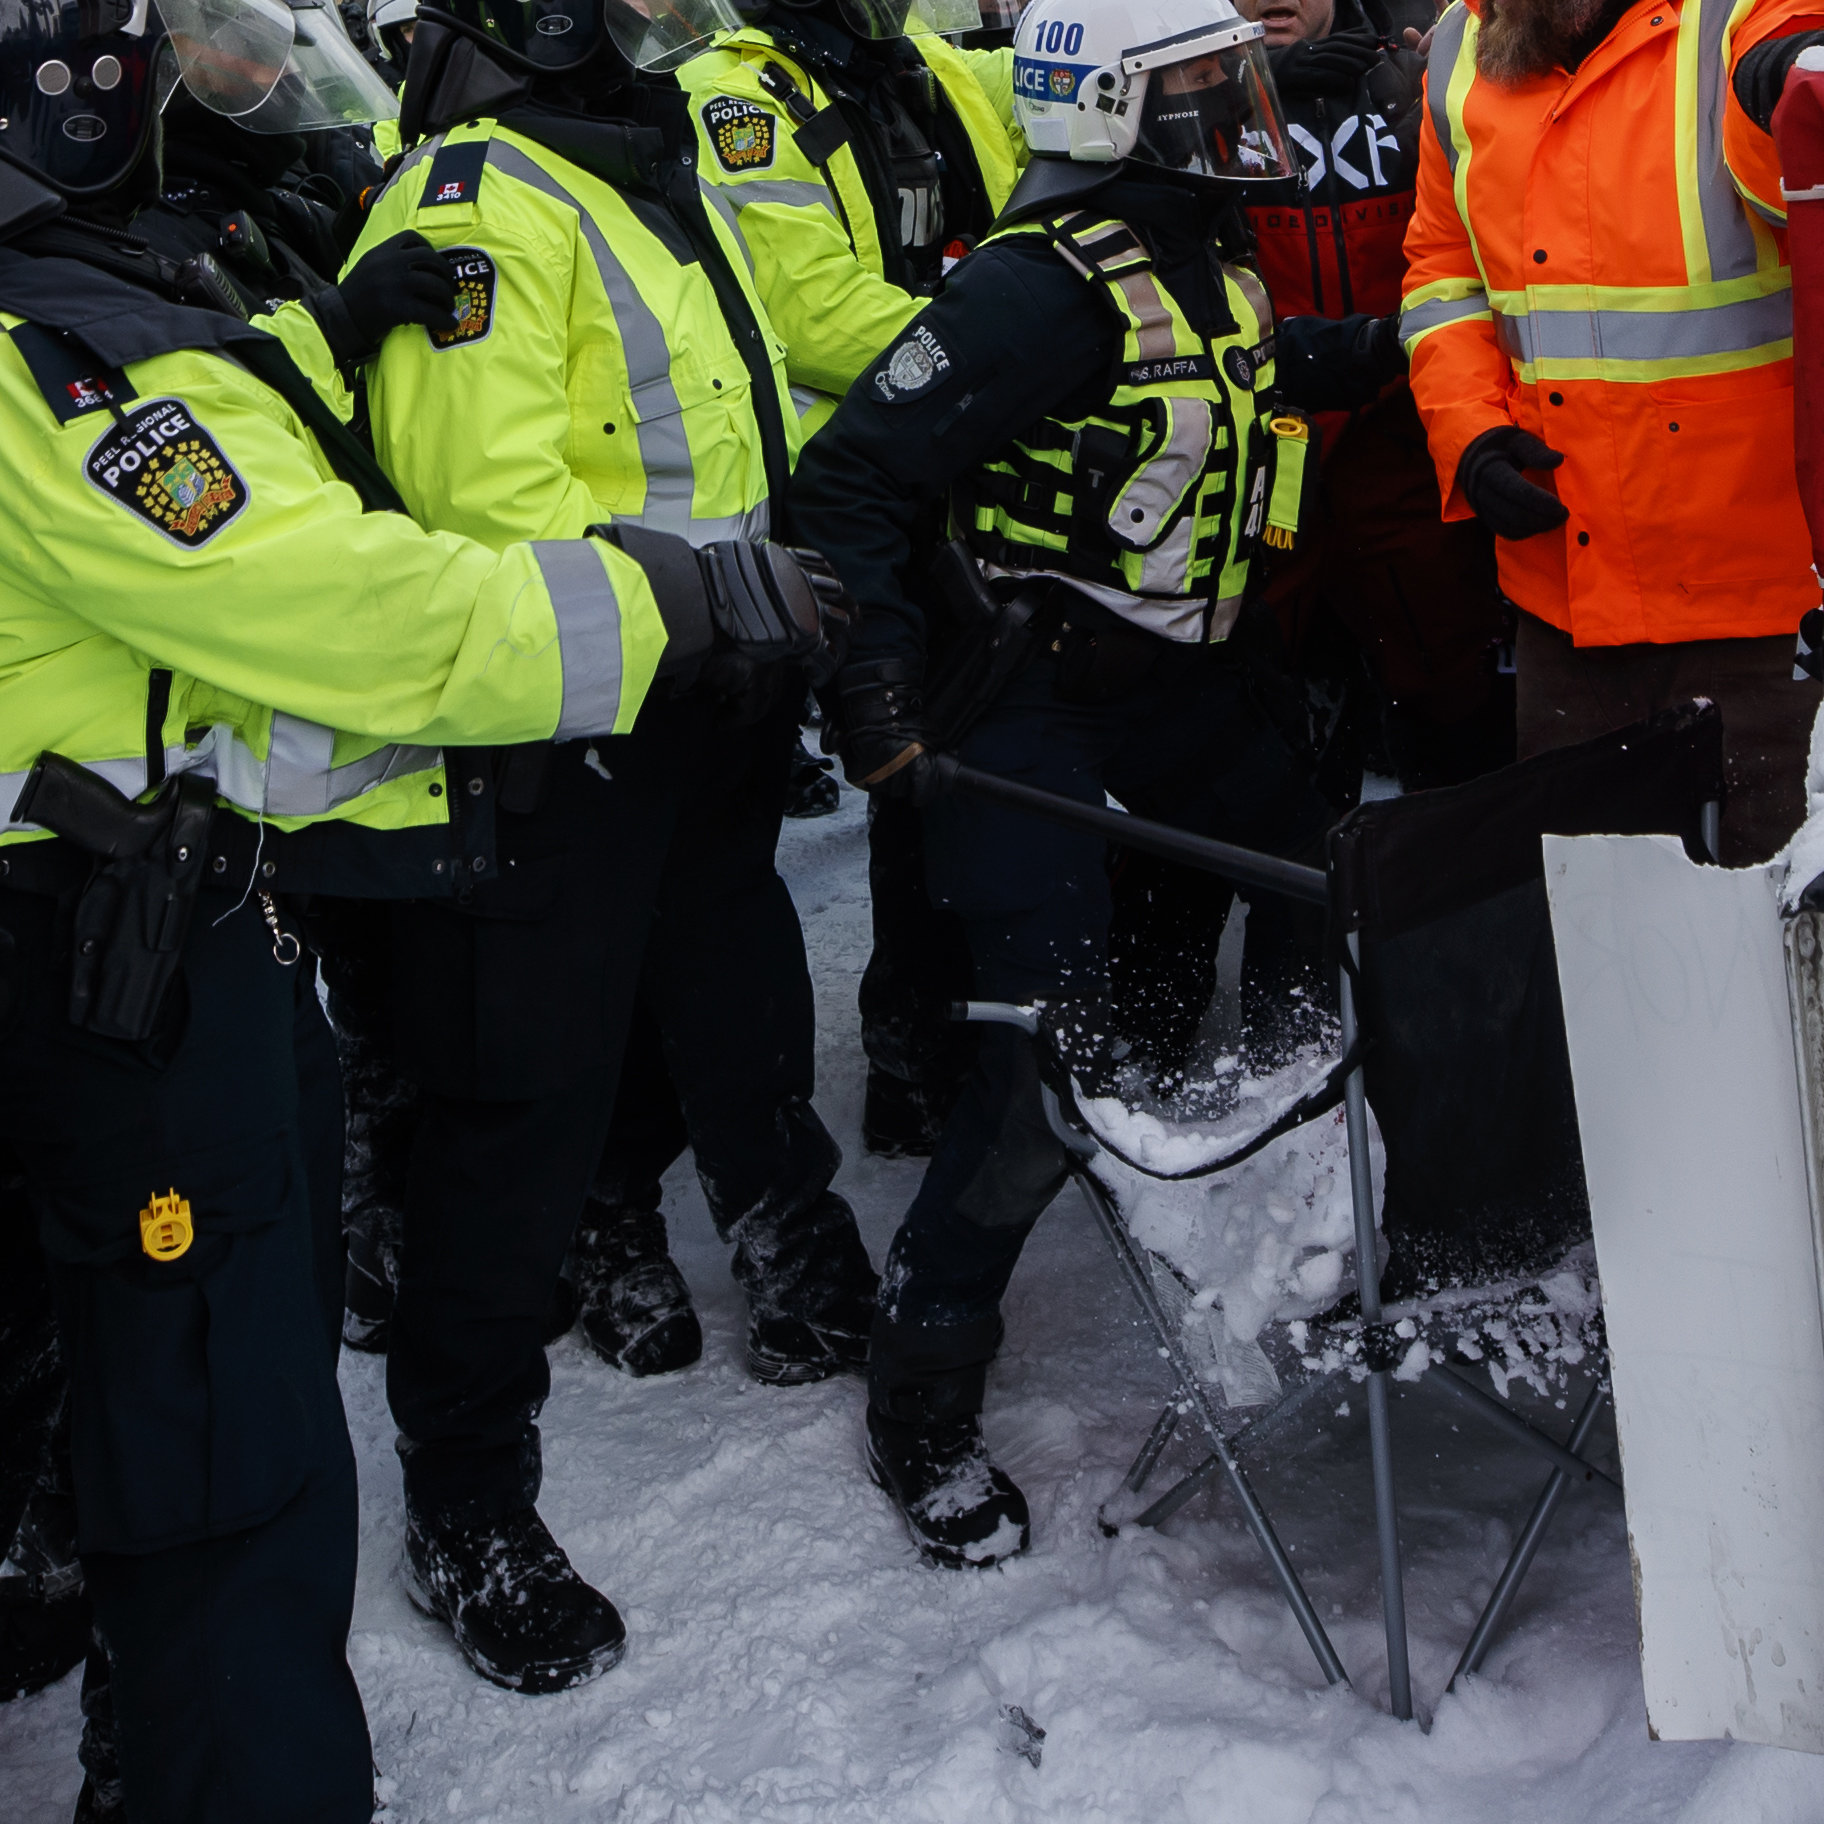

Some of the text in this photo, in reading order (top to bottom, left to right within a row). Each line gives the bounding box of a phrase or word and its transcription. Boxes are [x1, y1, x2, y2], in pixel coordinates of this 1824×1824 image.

[1035, 20, 1085, 56] 100
[454, 261, 490, 279] ICE
[914, 326, 950, 371] POLICE
[1154, 360, 1198, 377] RAFFA
[92, 403, 177, 472] PEEL RGIONAL
[103, 413, 190, 488] POLICE
